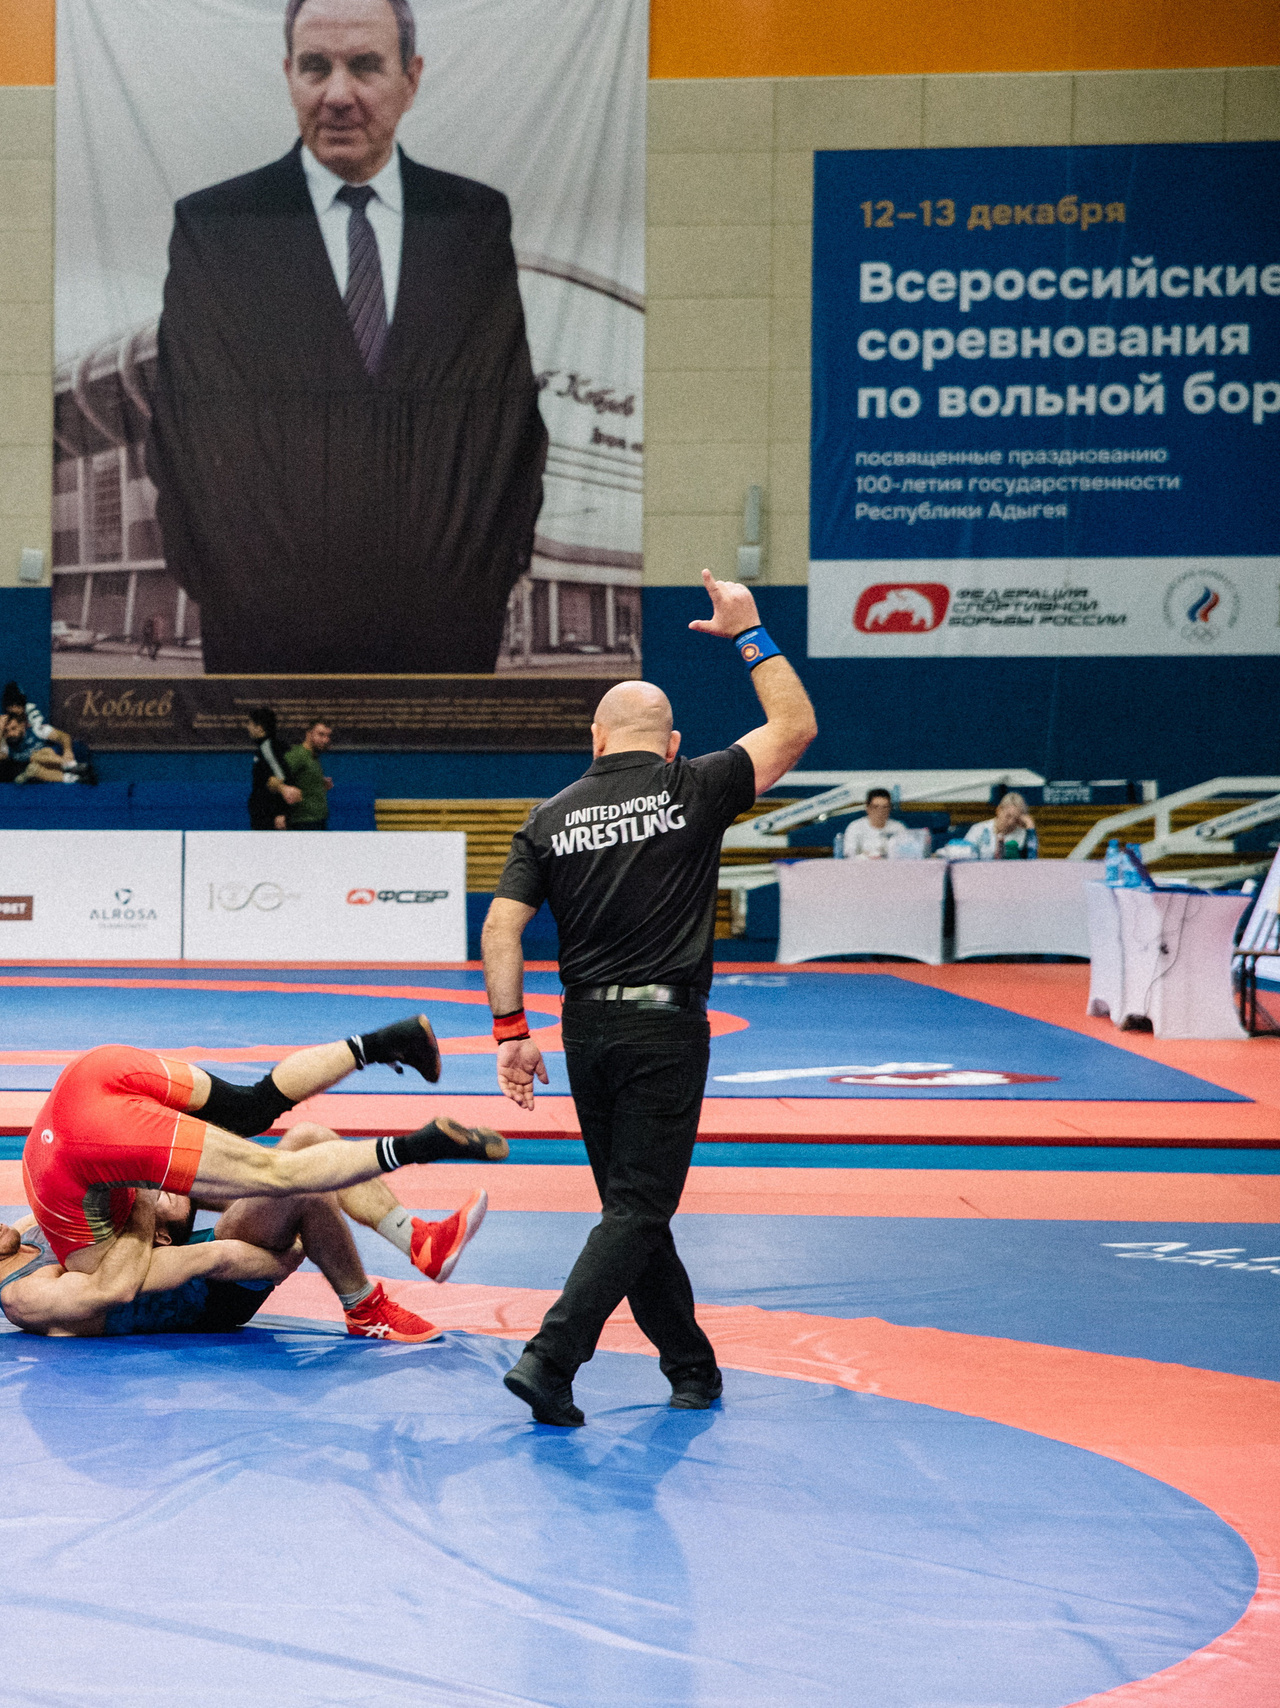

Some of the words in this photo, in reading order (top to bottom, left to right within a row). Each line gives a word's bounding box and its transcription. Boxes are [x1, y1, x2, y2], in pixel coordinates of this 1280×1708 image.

[966, 194, 1127, 231] декабря
[859, 256, 1280, 312] Всероссийские
[857, 323, 1250, 372] соревнования
[857, 386, 921, 419] по
[938, 373, 1166, 418] вольной
[855, 449, 1003, 468] посвященные
[1008, 448, 1168, 467] празднованию
[856, 475, 963, 493] 100-летия
[968, 475, 1181, 497] государственности
[855, 500, 983, 525] Республики
[988, 501, 1068, 521] Адыгея
[550, 803, 687, 857] WRESTLING
[564, 803, 621, 827] UNITED
